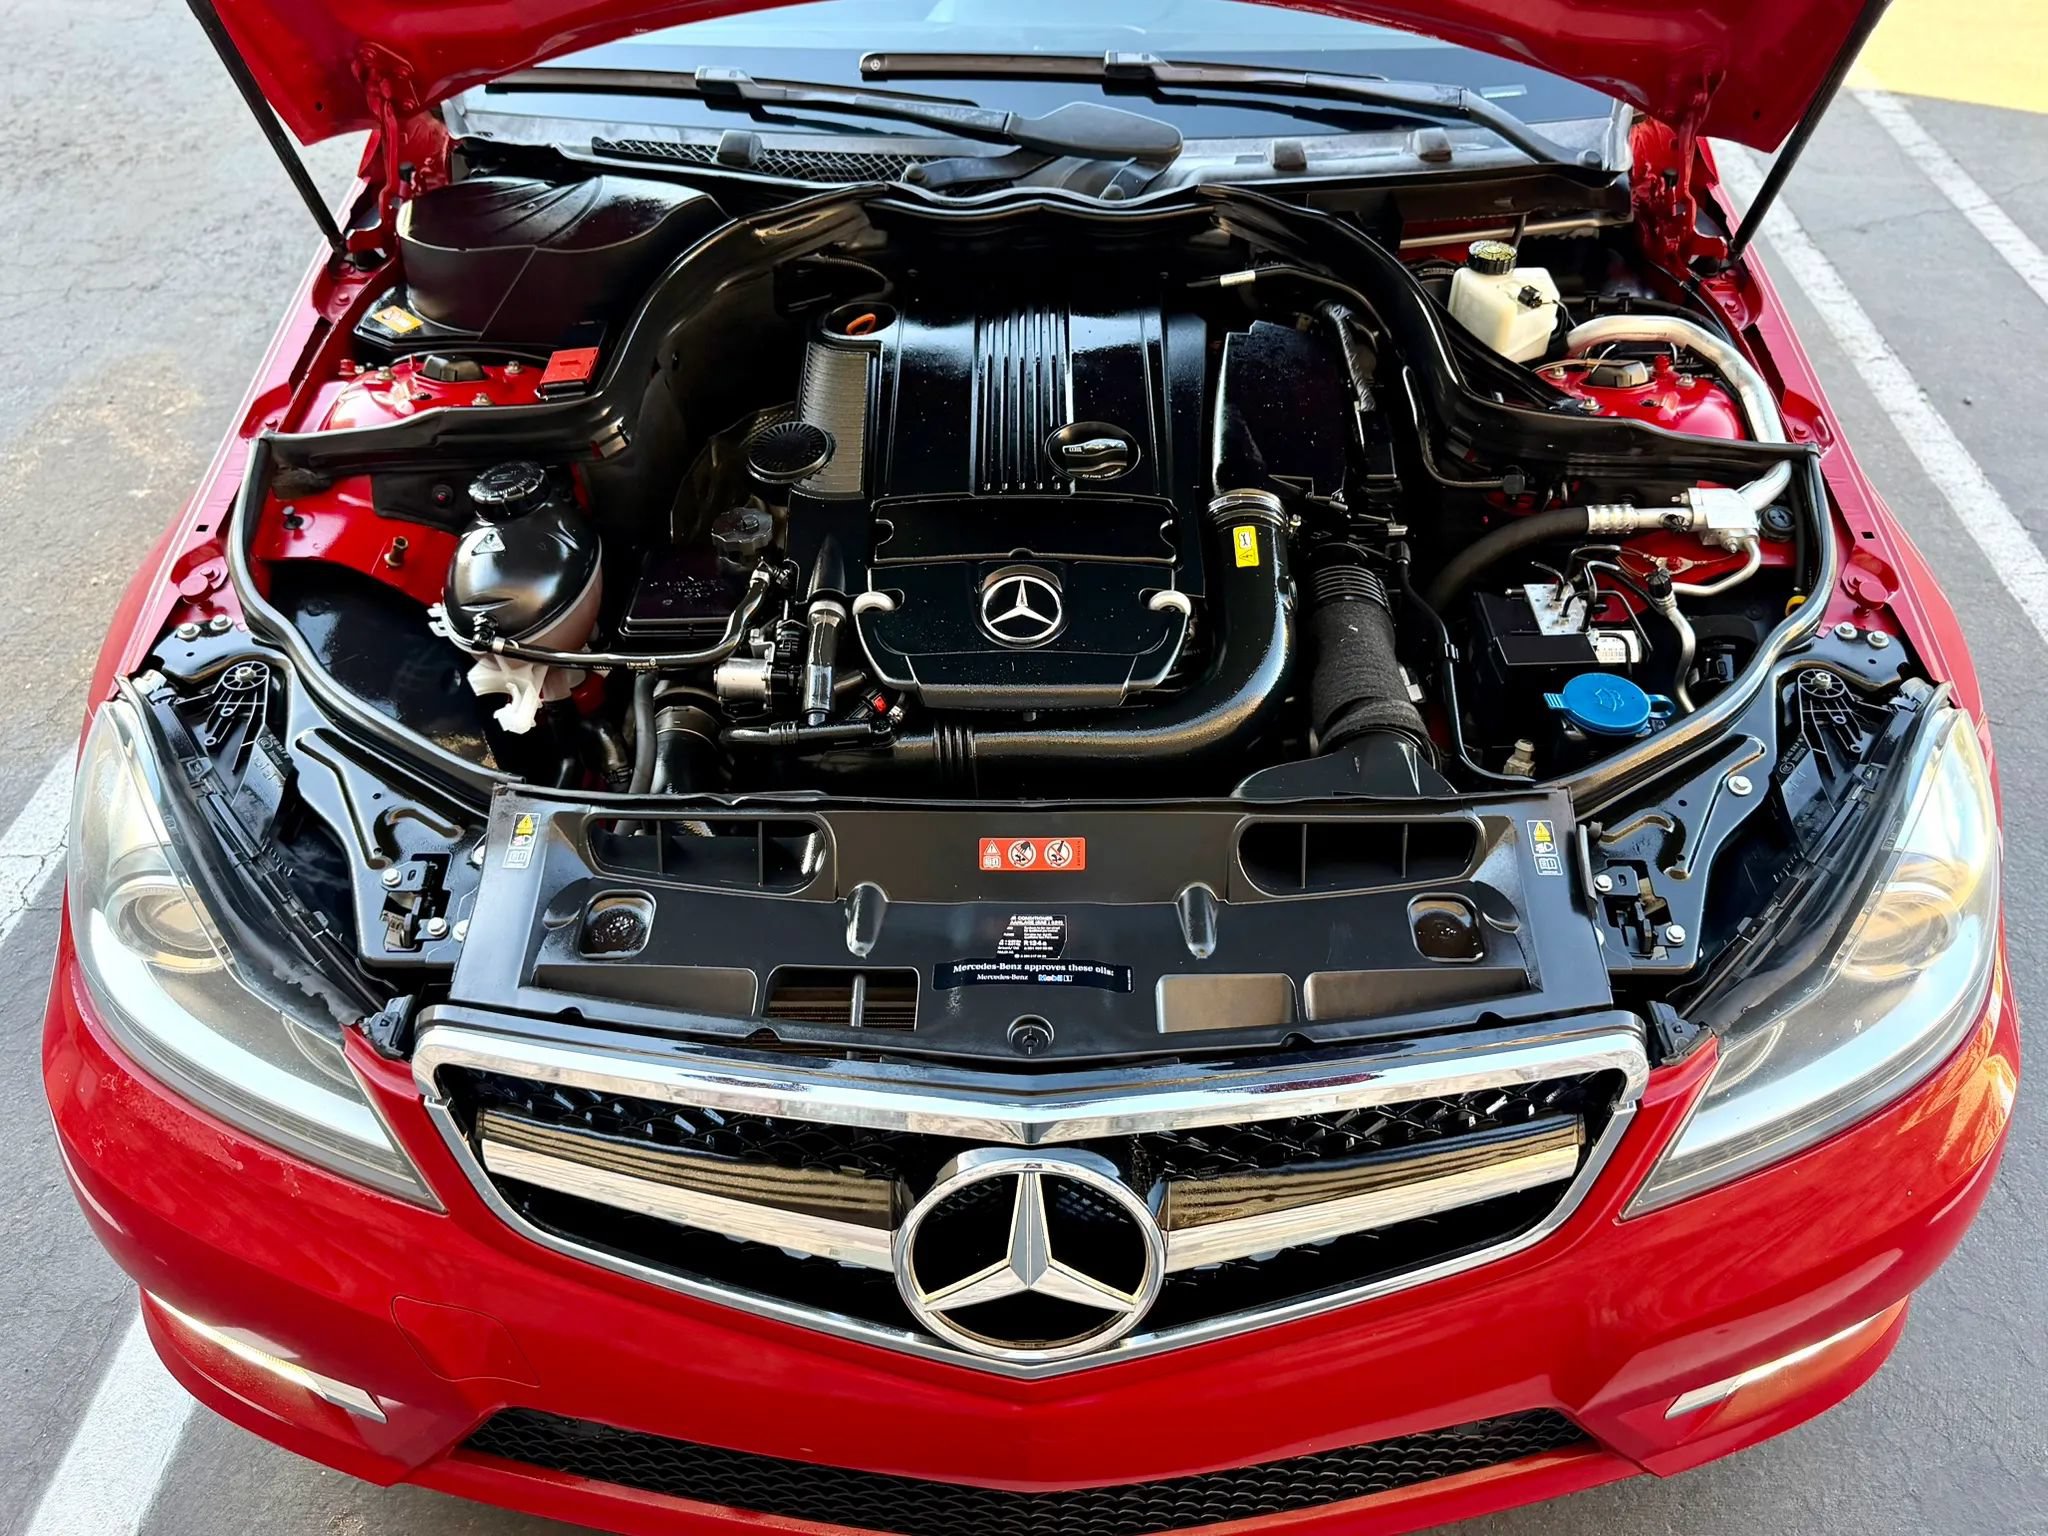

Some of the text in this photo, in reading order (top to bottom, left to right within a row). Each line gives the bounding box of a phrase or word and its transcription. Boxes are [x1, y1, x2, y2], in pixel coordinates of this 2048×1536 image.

[953, 962, 1114, 976] Mercedes-Benz approves these oils:
[1038, 974, 1062, 982] Mobil
